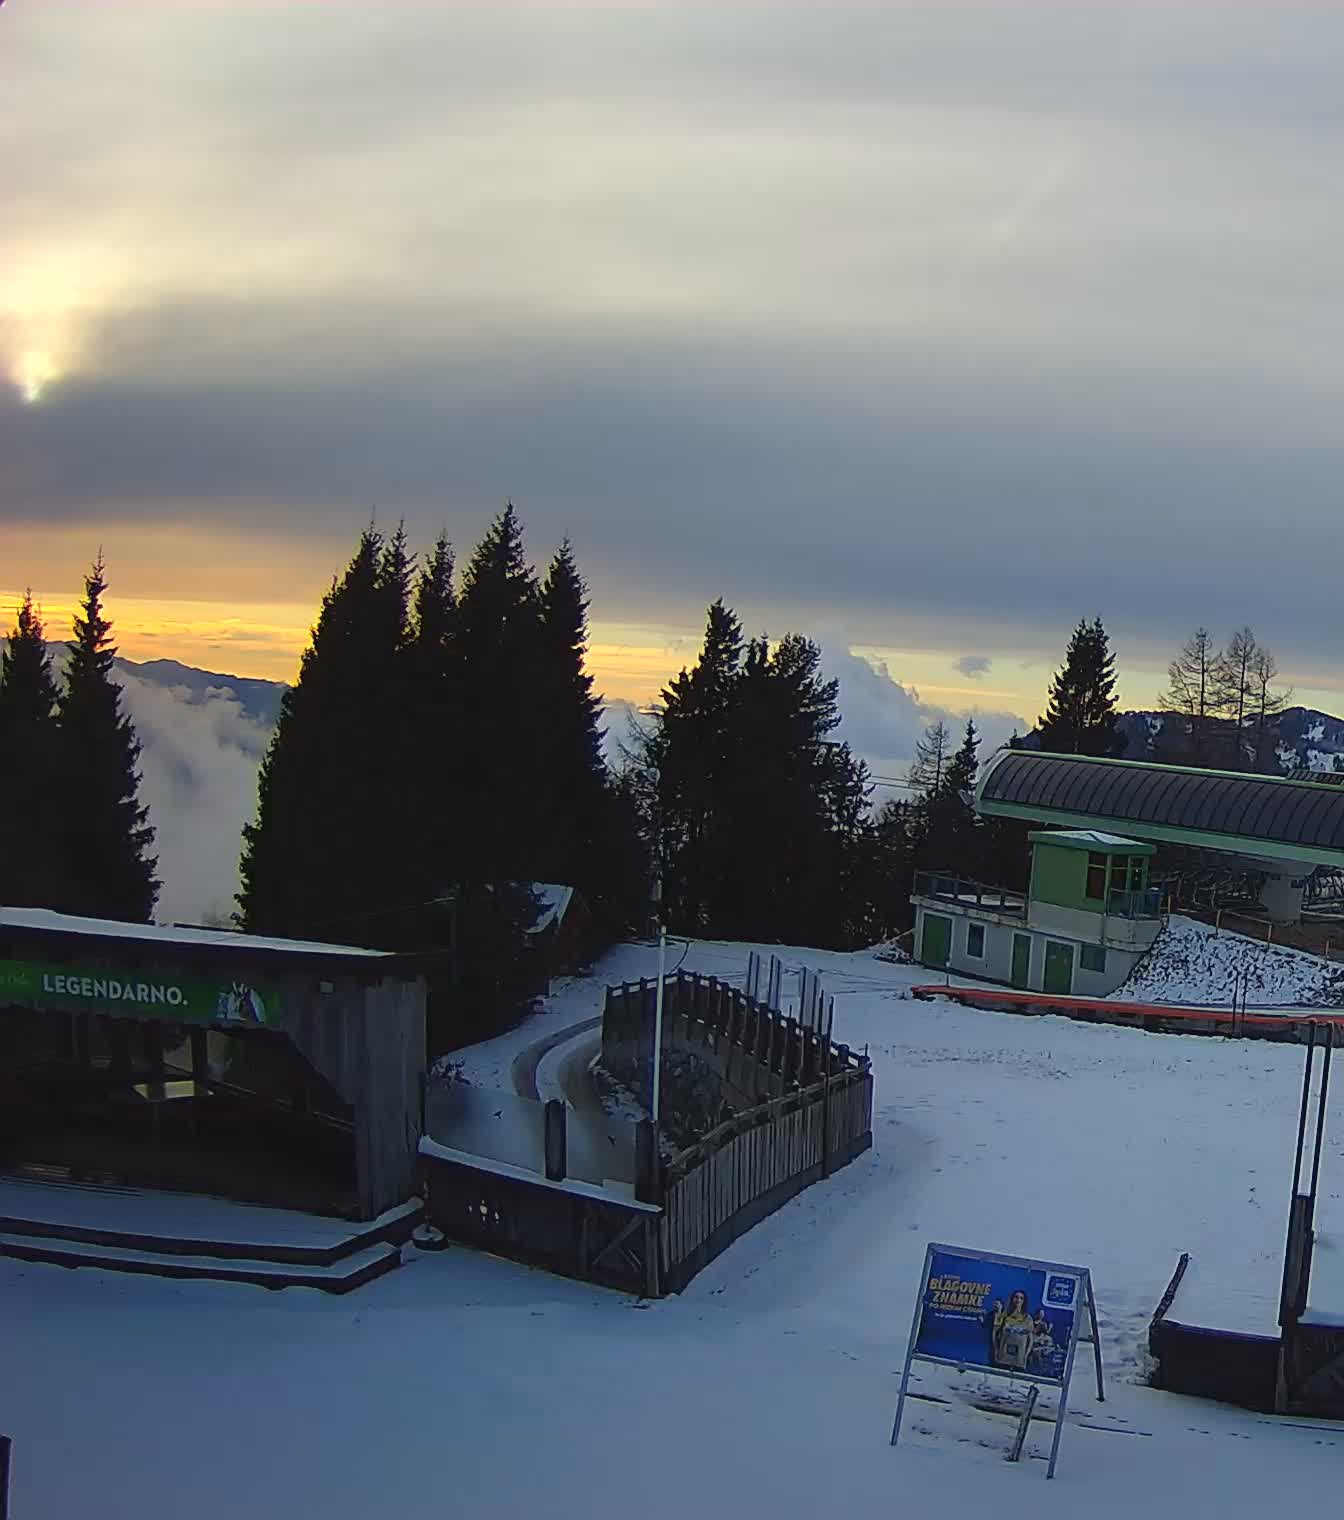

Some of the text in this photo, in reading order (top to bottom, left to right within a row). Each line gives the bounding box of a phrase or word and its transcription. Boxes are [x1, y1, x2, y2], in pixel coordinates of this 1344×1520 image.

[43, 974, 188, 1006] LEGENDARNO.
[929, 1278, 992, 1296] BLAGOVNE
[932, 1291, 985, 1307] ZNAMKE
